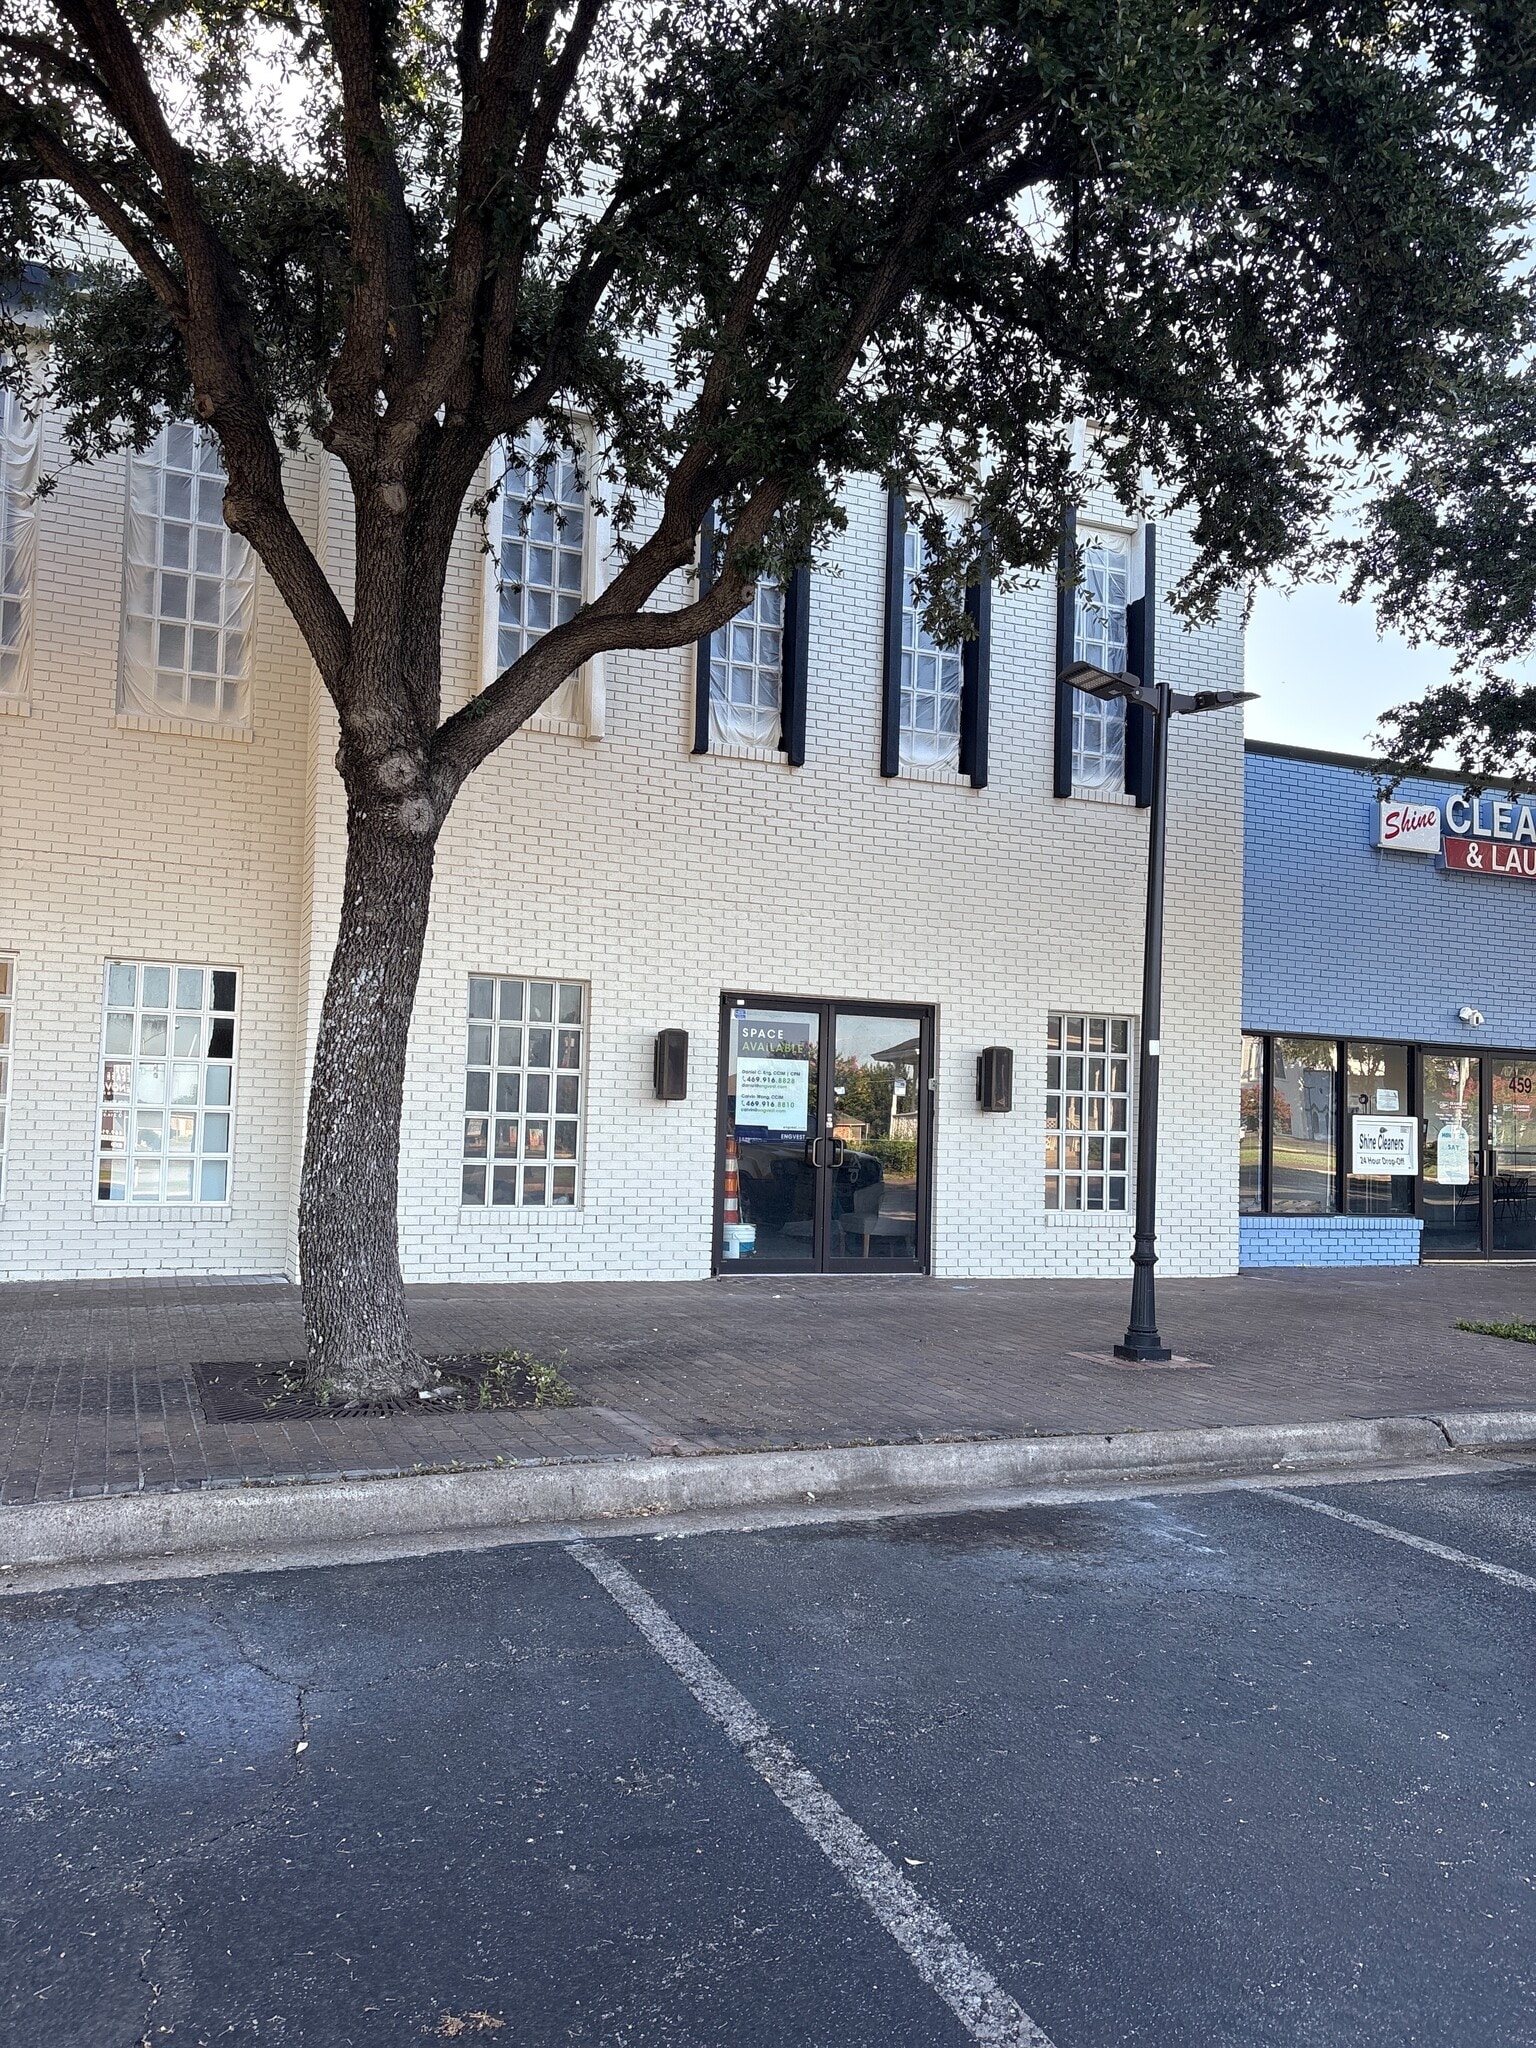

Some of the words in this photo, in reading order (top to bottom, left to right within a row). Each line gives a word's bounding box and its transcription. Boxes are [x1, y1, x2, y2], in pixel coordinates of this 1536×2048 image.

[1384, 806, 1437, 839] Shine
[1445, 794, 1536, 843] CLEA
[1466, 842, 1483, 868] &
[1492, 845, 1536, 875] LAU
[742, 1027, 784, 1039] SPACE
[742, 1041, 804, 1054] AVAILABLE
[746, 1076, 795, 1084] 469.916.8828
[1509, 1077, 1532, 1094] 459
[745, 1100, 794, 1108] 469.916.8810
[1359, 1133, 1376, 1149] Shine
[1378, 1133, 1404, 1150] Cleaners
[1360, 1156, 1367, 1164] 24
[1367, 1156, 1381, 1165] Hour
